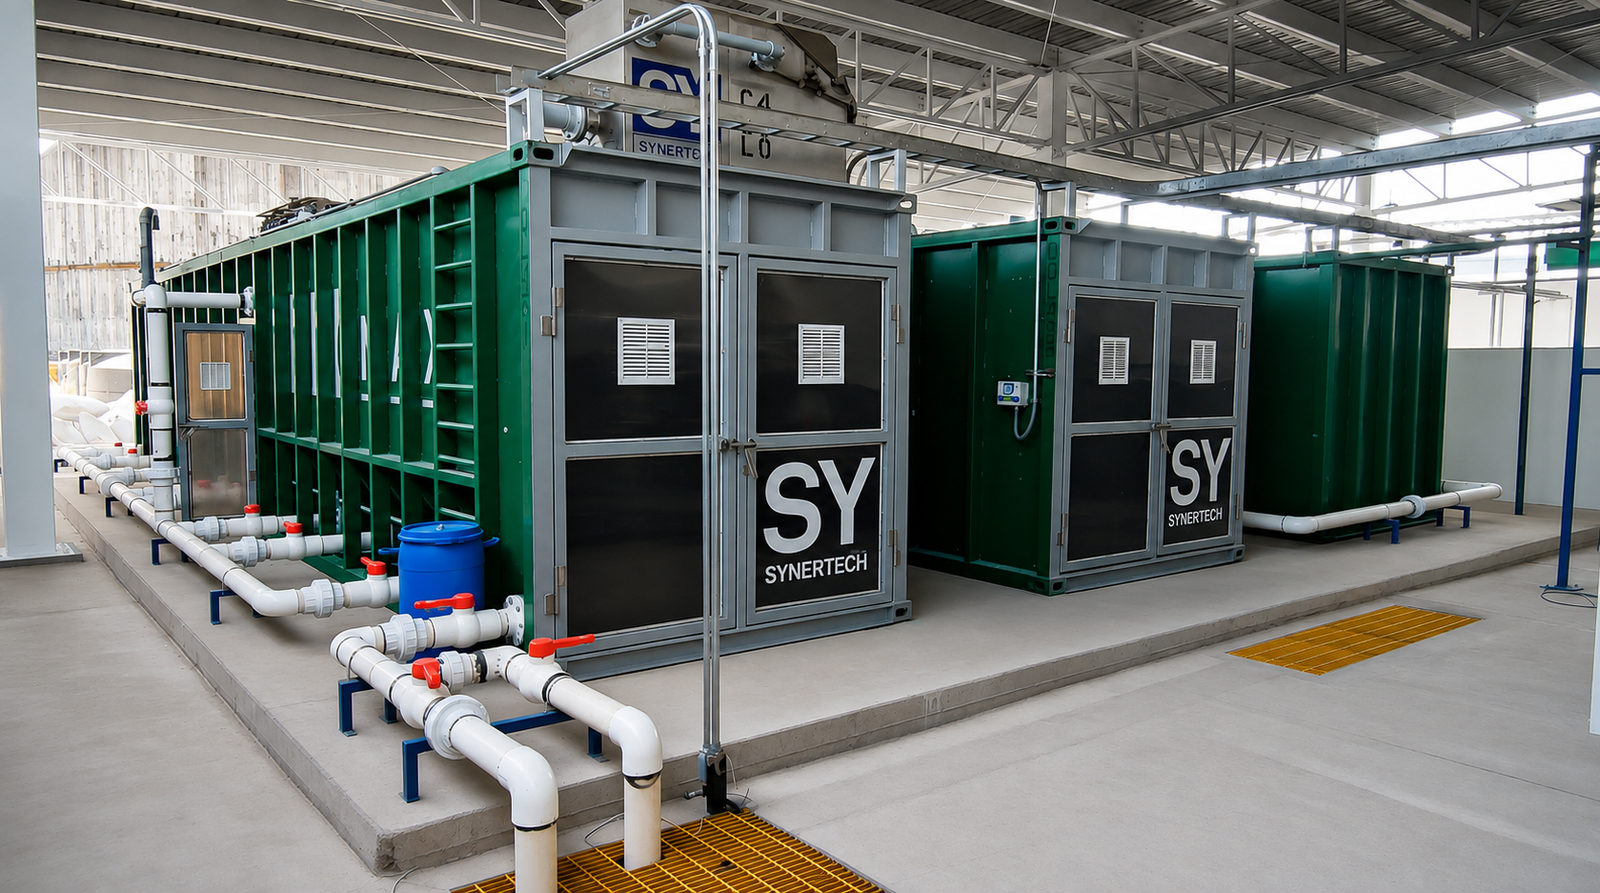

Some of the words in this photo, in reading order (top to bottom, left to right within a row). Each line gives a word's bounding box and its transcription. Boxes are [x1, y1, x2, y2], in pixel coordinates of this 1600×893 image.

[1170, 437, 1231, 506] SY
[763, 457, 876, 554] SY
[1168, 507, 1223, 527] SYNERTECH
[764, 552, 868, 584] SYNERTECH
